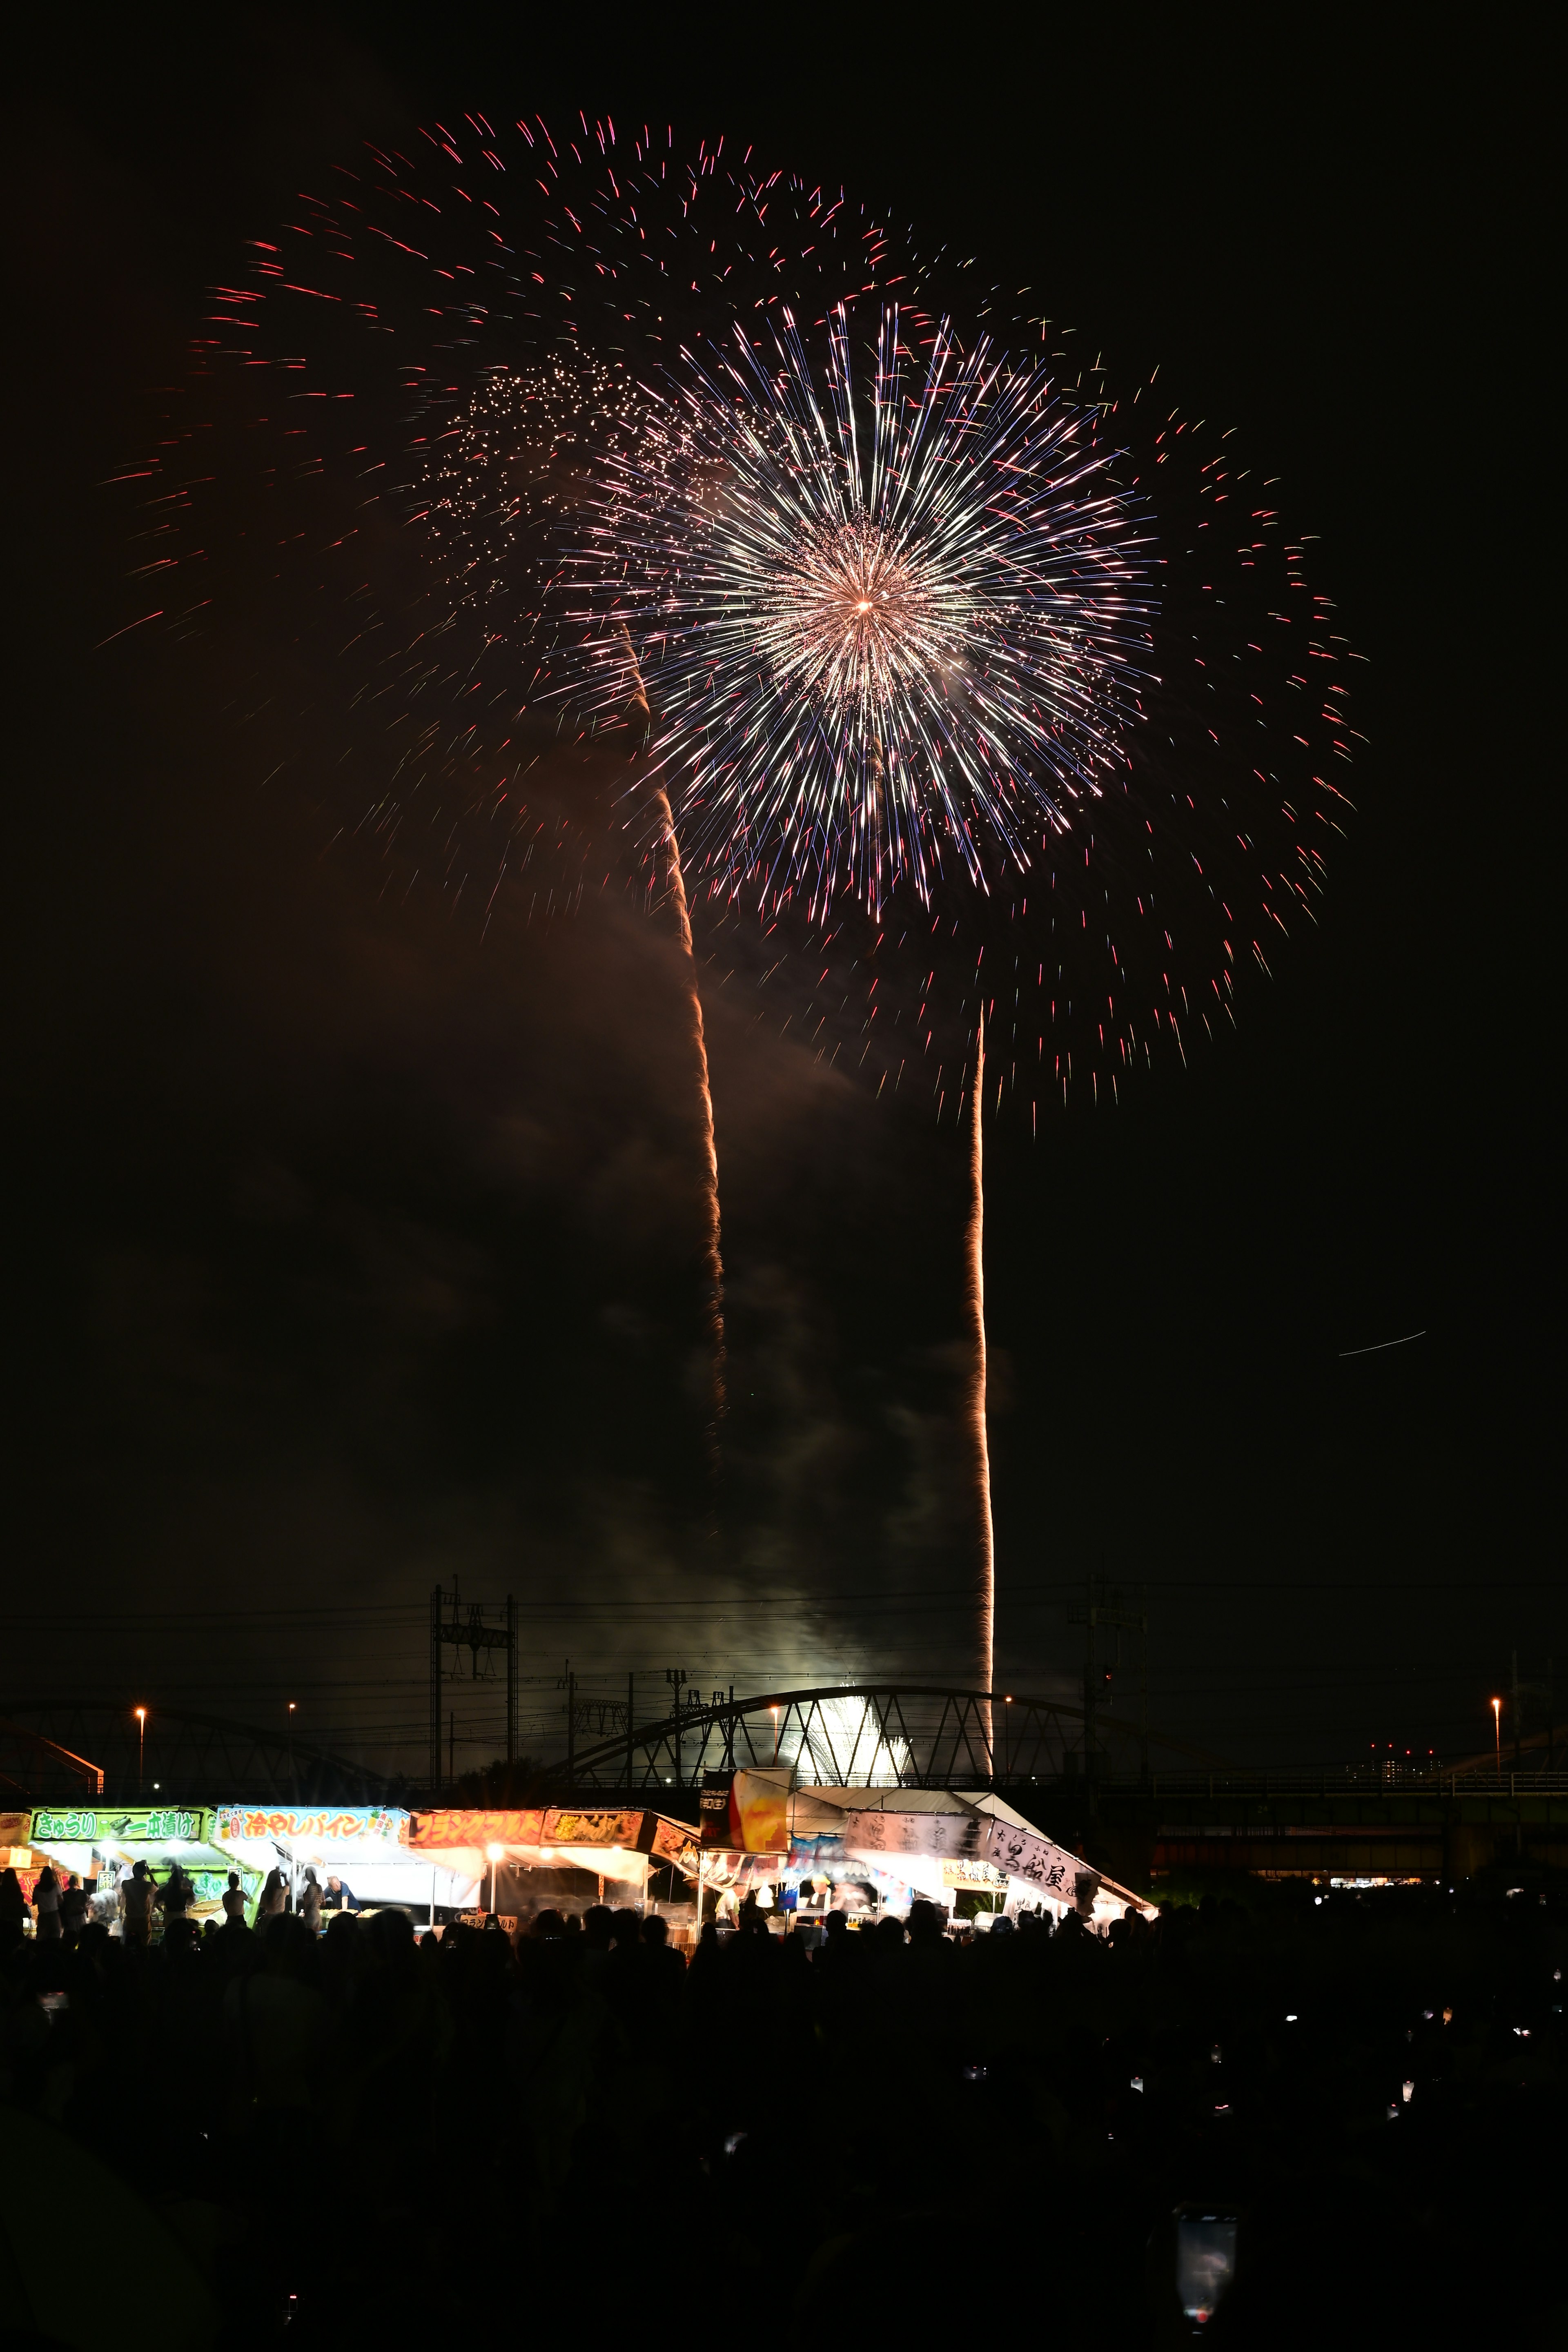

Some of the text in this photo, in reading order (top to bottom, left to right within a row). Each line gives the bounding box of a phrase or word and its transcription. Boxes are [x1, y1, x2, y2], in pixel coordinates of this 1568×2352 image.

[38, 1813, 97, 1838] きゅうり
[126, 1812, 194, 1838] 一本漬け
[245, 1811, 365, 1838] 冷やしパイン
[415, 1813, 540, 1842] フランクフルト
[1004, 1840, 1066, 1892] 黒船屋
[461, 1919, 514, 1929] フランルト
